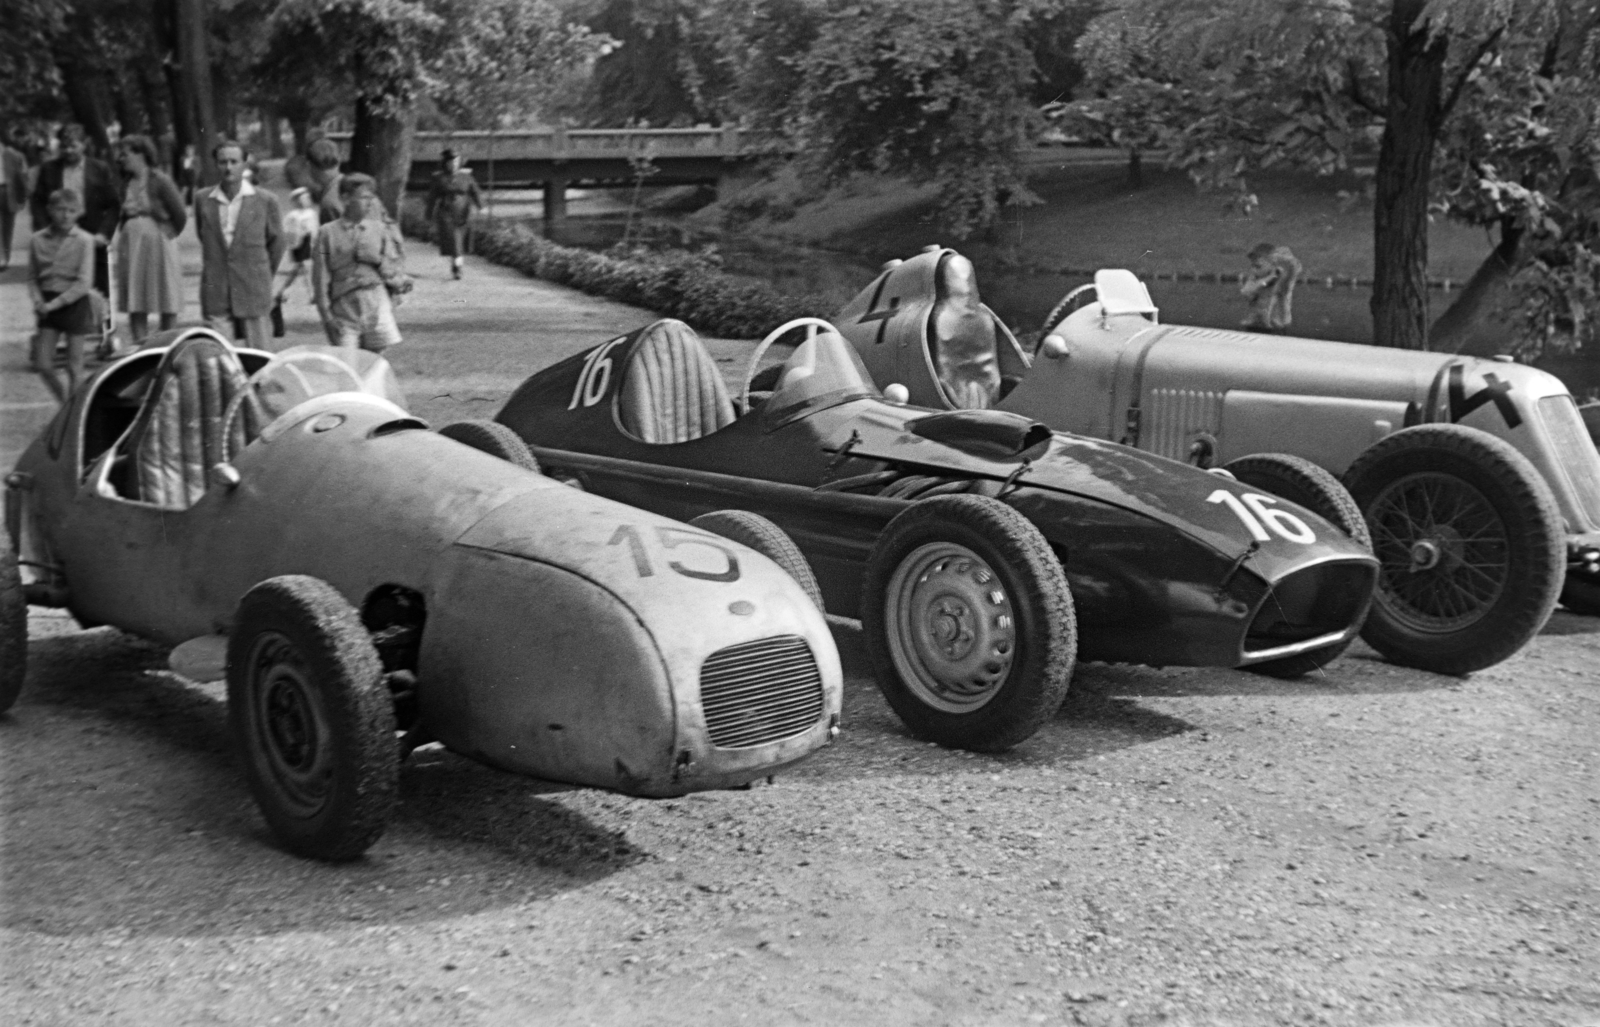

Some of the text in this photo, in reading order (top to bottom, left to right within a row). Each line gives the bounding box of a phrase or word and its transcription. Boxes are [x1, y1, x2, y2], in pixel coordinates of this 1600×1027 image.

[856, 269, 901, 345] 4
[567, 336, 628, 411] 16
[1448, 364, 1523, 430] 4
[1205, 489, 1317, 545] 16
[606, 524, 741, 583] 15
